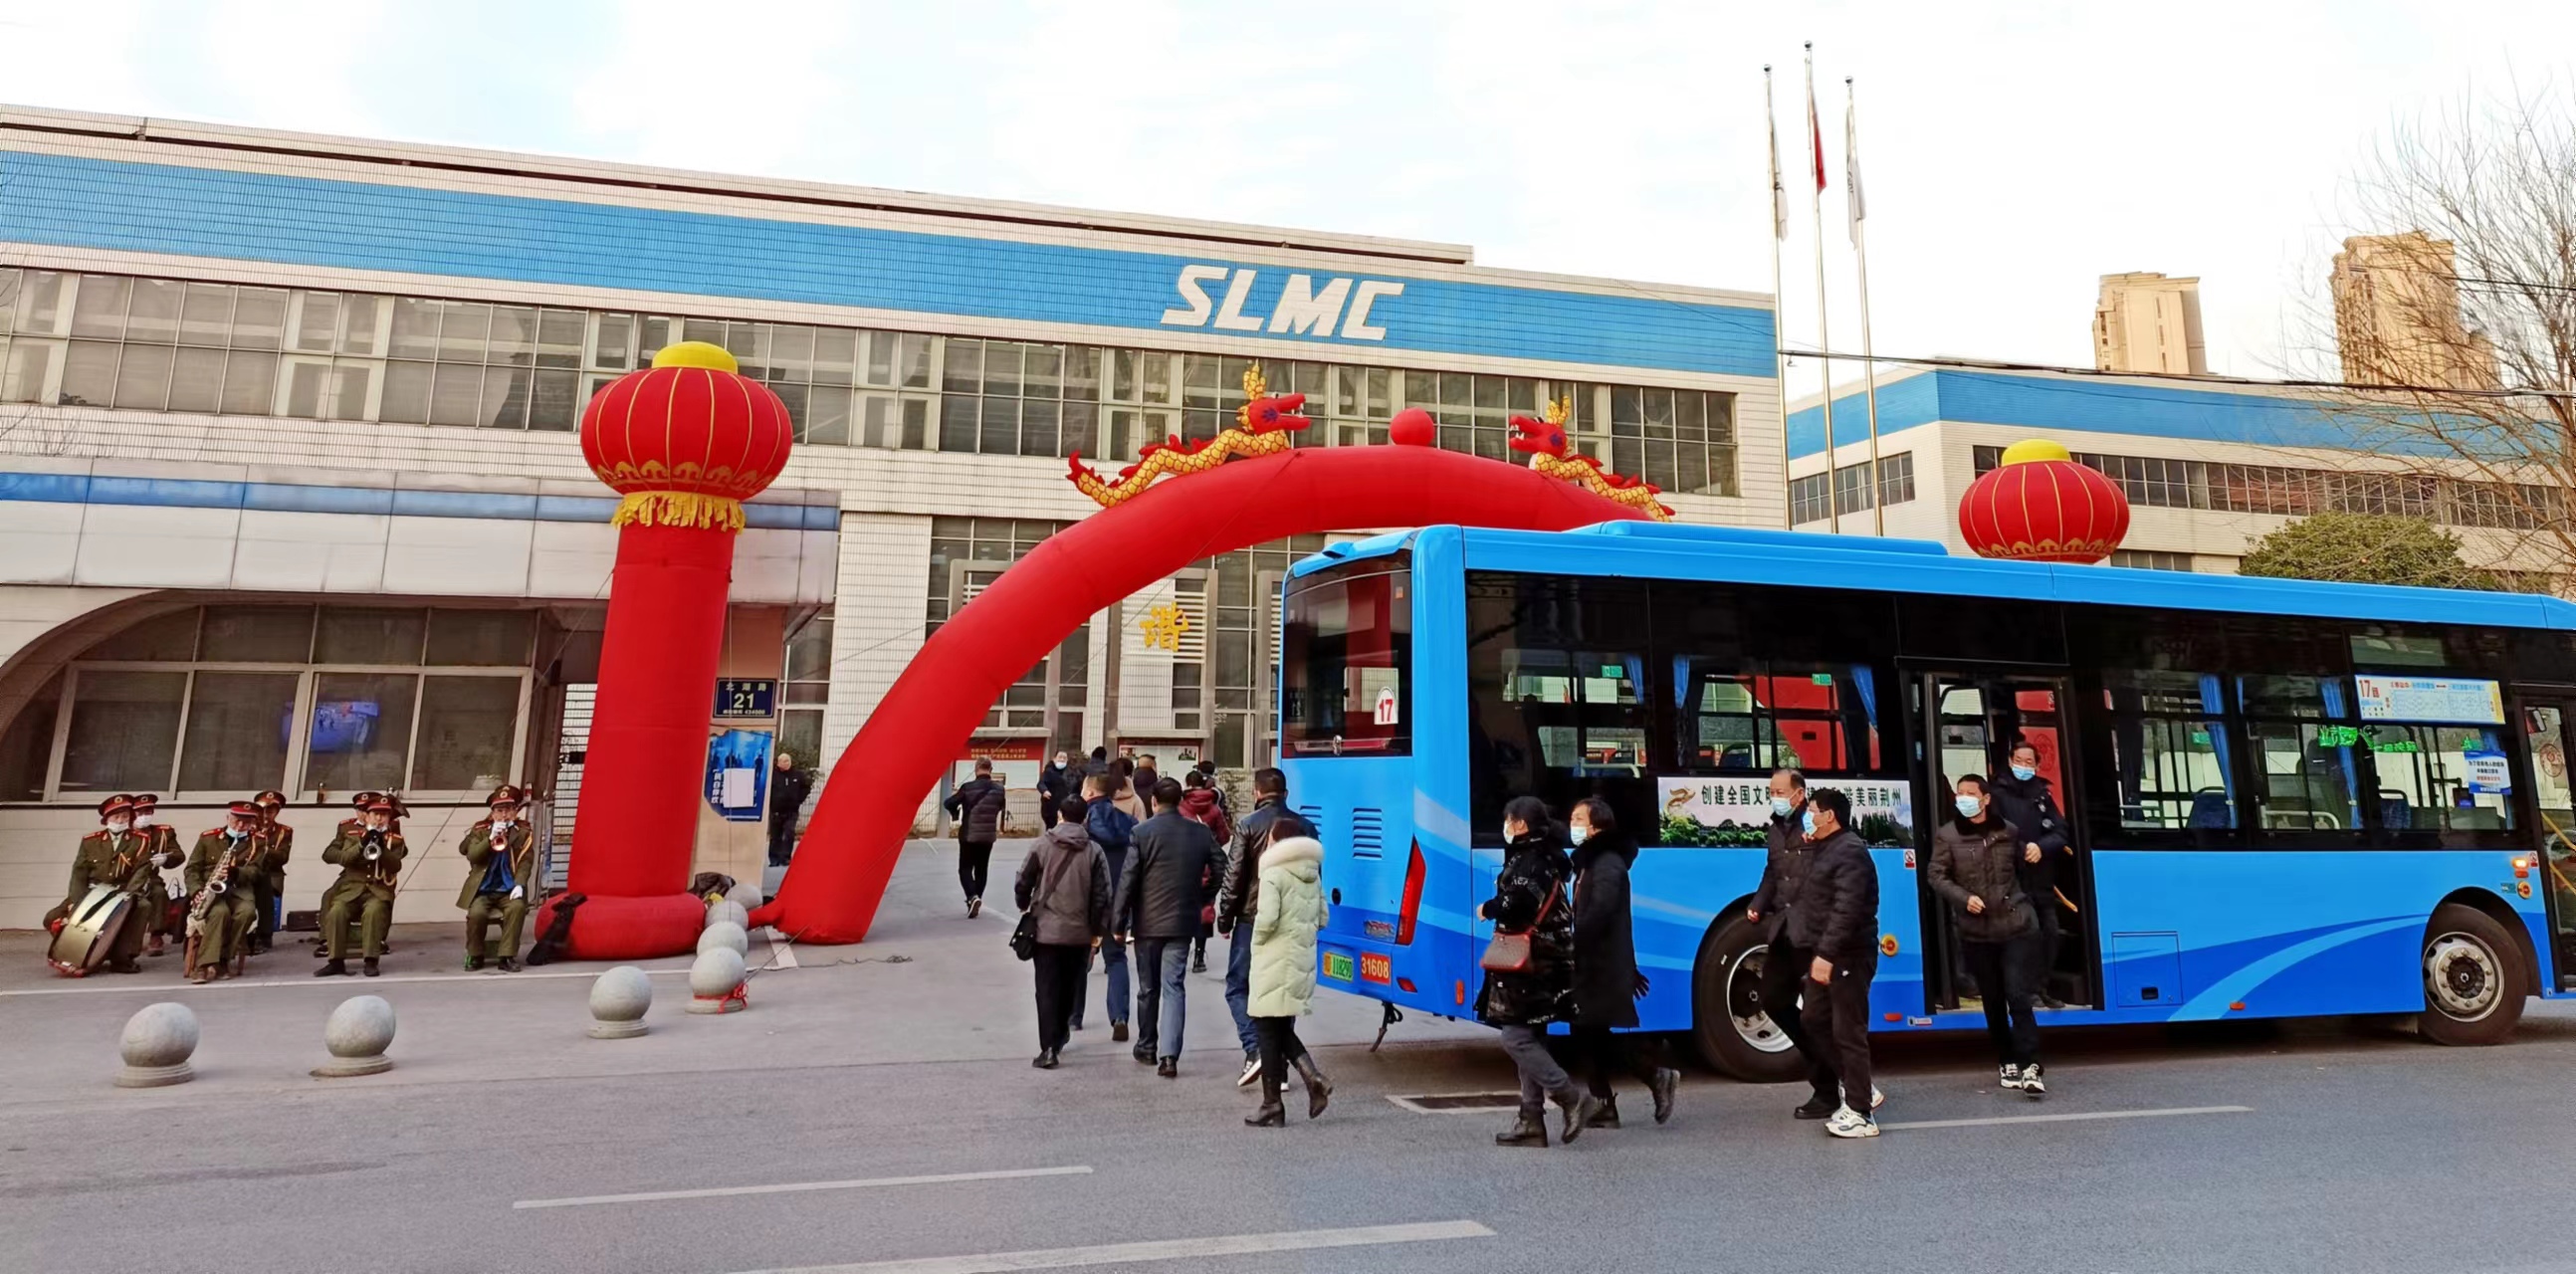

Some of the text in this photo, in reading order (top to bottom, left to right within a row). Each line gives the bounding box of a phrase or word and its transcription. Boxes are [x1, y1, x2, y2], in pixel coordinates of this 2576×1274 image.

[1161, 265, 1404, 340] SLMC
[1140, 601, 1188, 652] 谐
[733, 693, 754, 709] 21
[1379, 699, 1394, 722] 17
[1361, 956, 1390, 979] 31608
